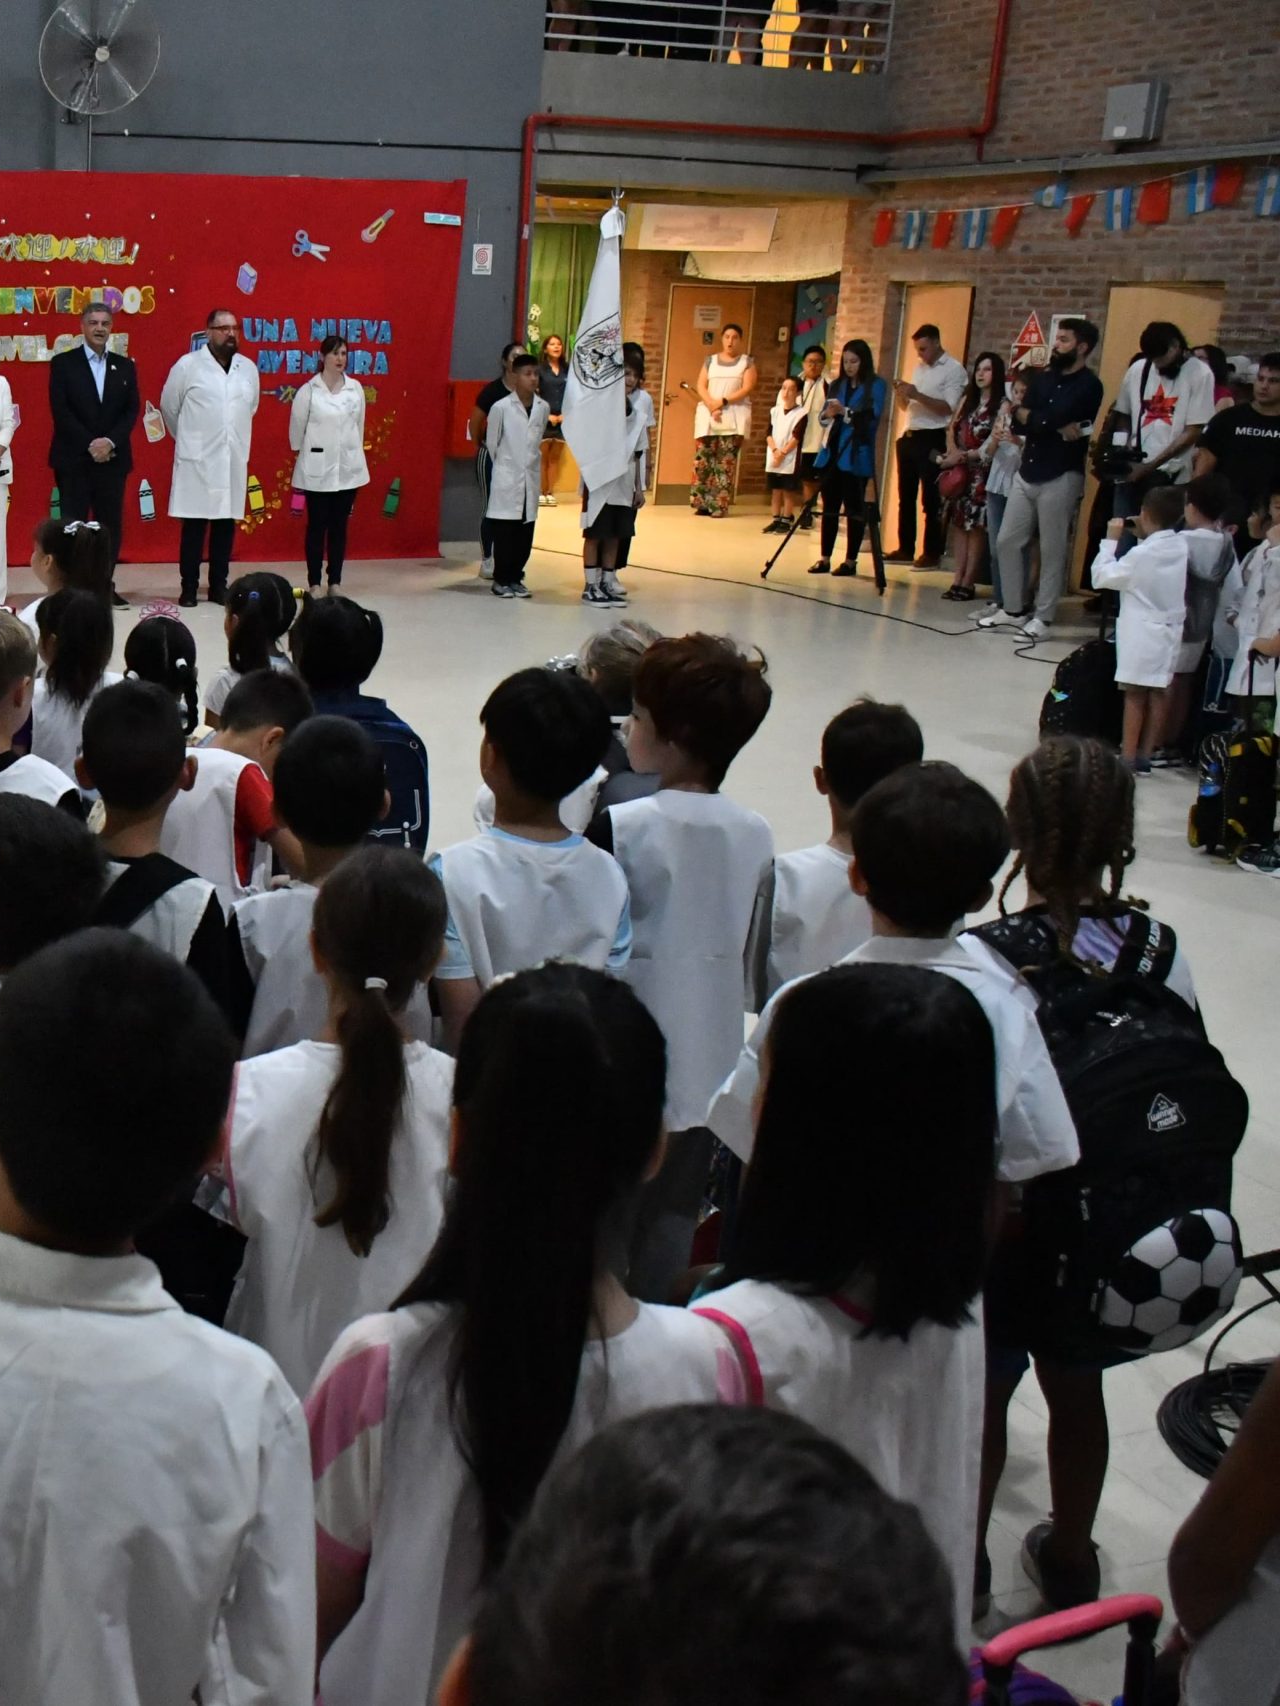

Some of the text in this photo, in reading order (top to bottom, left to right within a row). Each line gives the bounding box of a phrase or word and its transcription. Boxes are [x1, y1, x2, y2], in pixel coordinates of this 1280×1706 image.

[242, 318, 392, 344] UNA NUEVA
[257, 350, 389, 375] AVENRA
